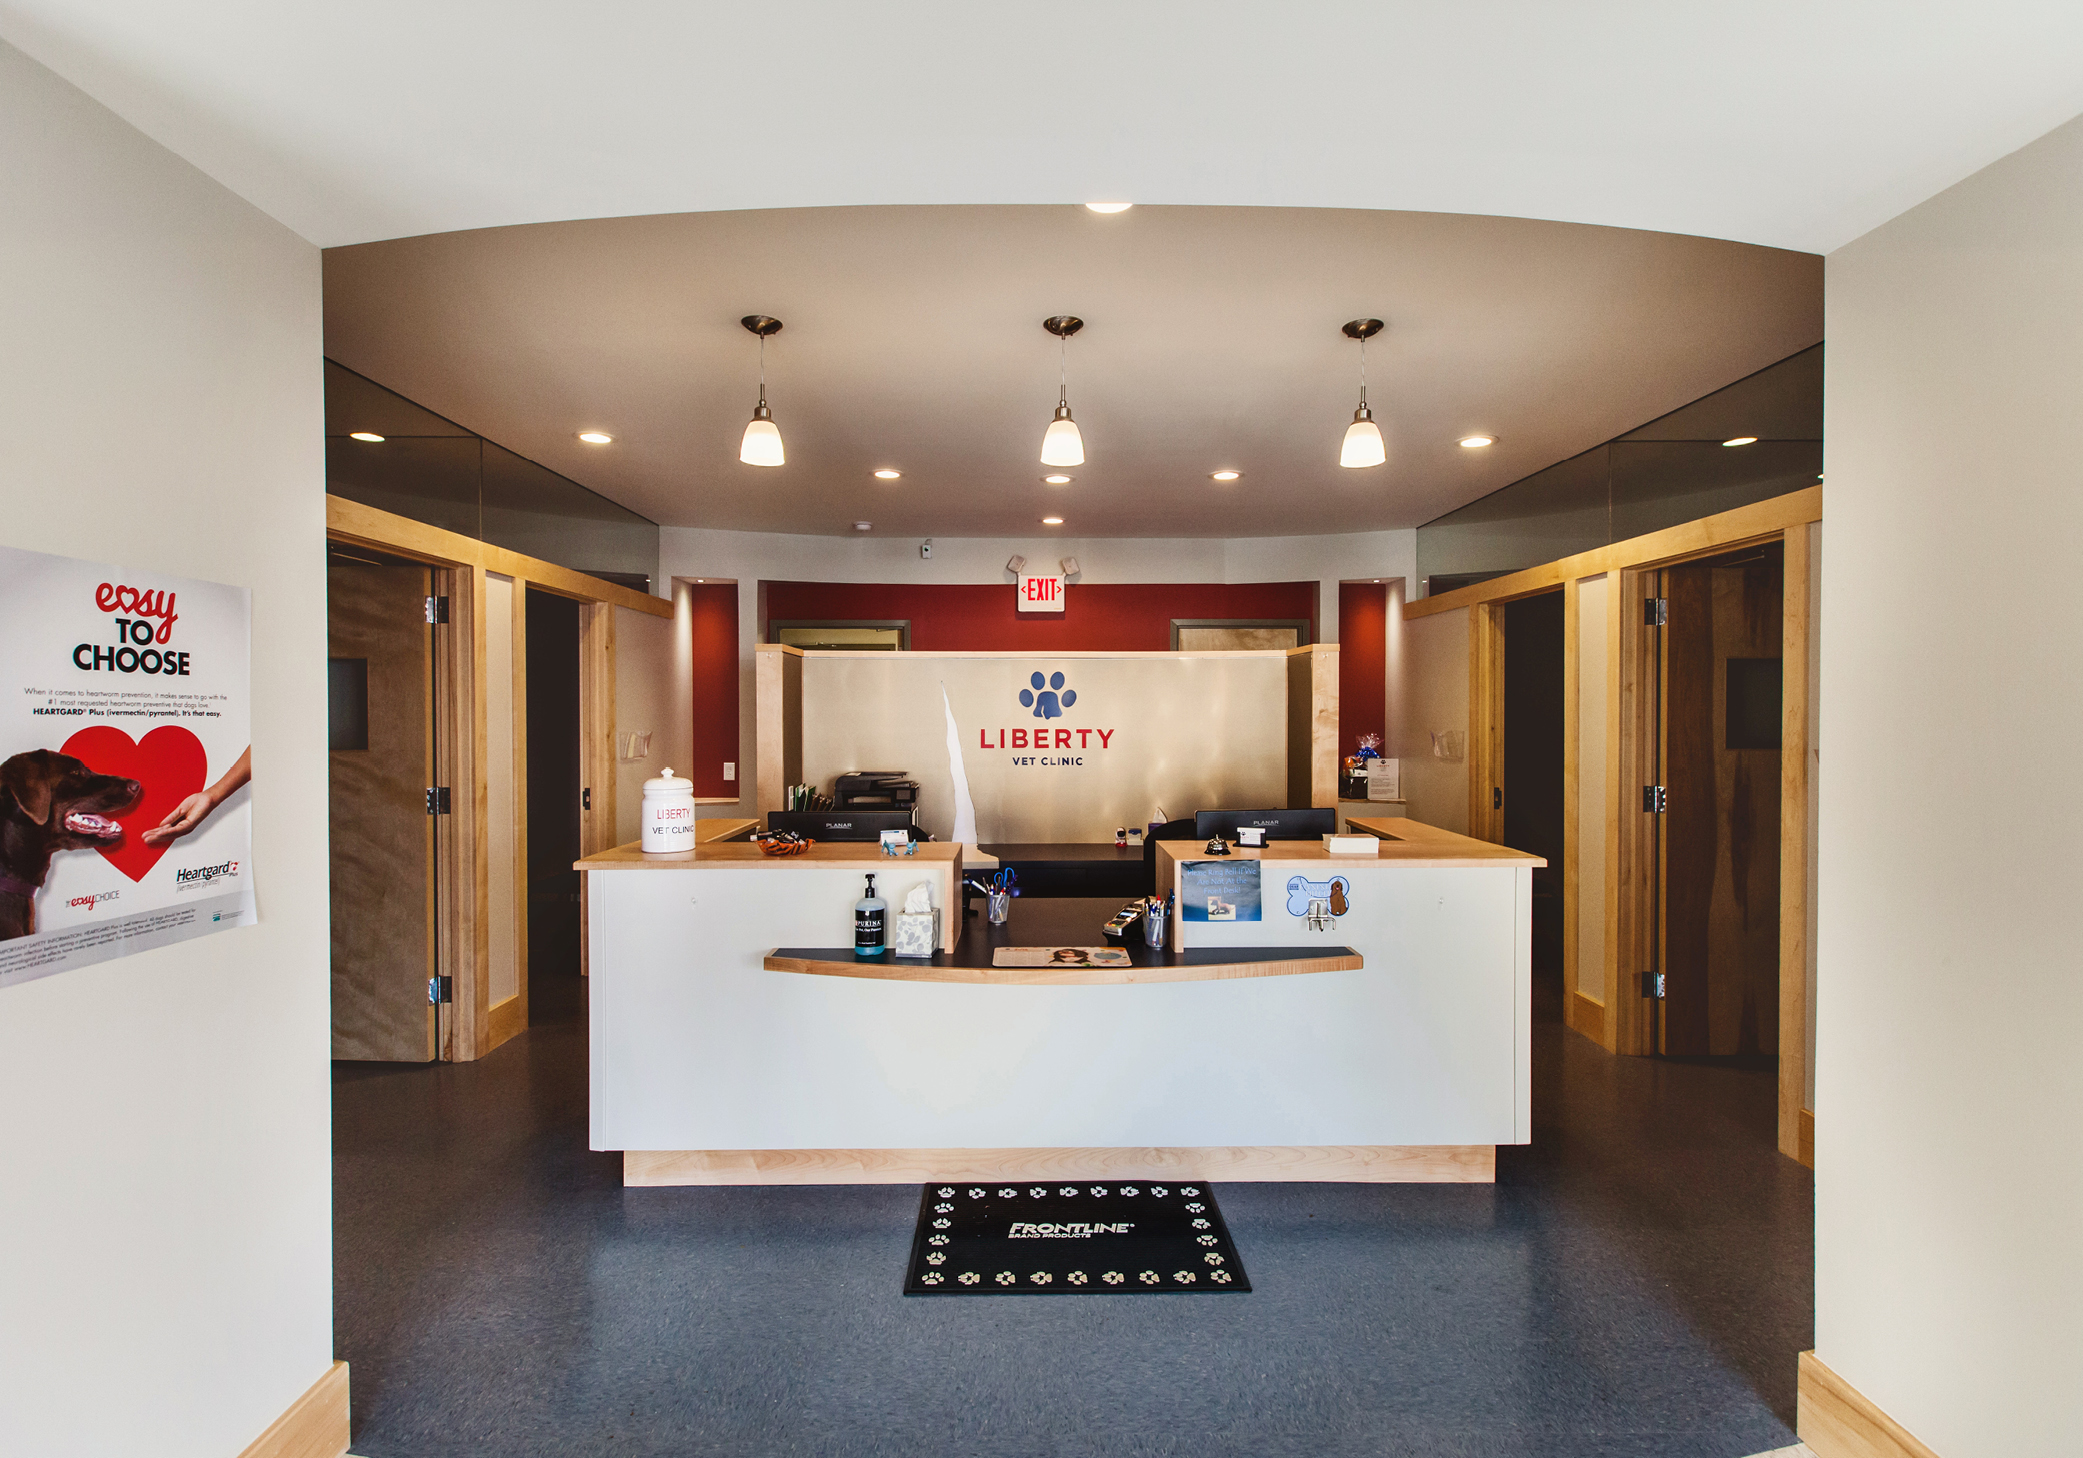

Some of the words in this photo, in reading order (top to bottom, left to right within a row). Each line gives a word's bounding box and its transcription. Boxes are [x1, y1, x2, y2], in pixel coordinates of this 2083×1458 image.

[1028, 578, 1057, 600] EXIT
[115, 618, 154, 646] TO
[72, 643, 190, 676] CHOOSE
[86, 689, 119, 697] heartworm
[121, 691, 153, 699] prevention,
[980, 729, 1114, 748] LIBERTY
[1013, 757, 1036, 765] VET
[1041, 757, 1083, 766] CLINIC
[657, 808, 690, 819] LIBERTY
[672, 825, 694, 834] CLINIC
[177, 861, 231, 880] Heartgard
[1208, 869, 1223, 877] Ring
